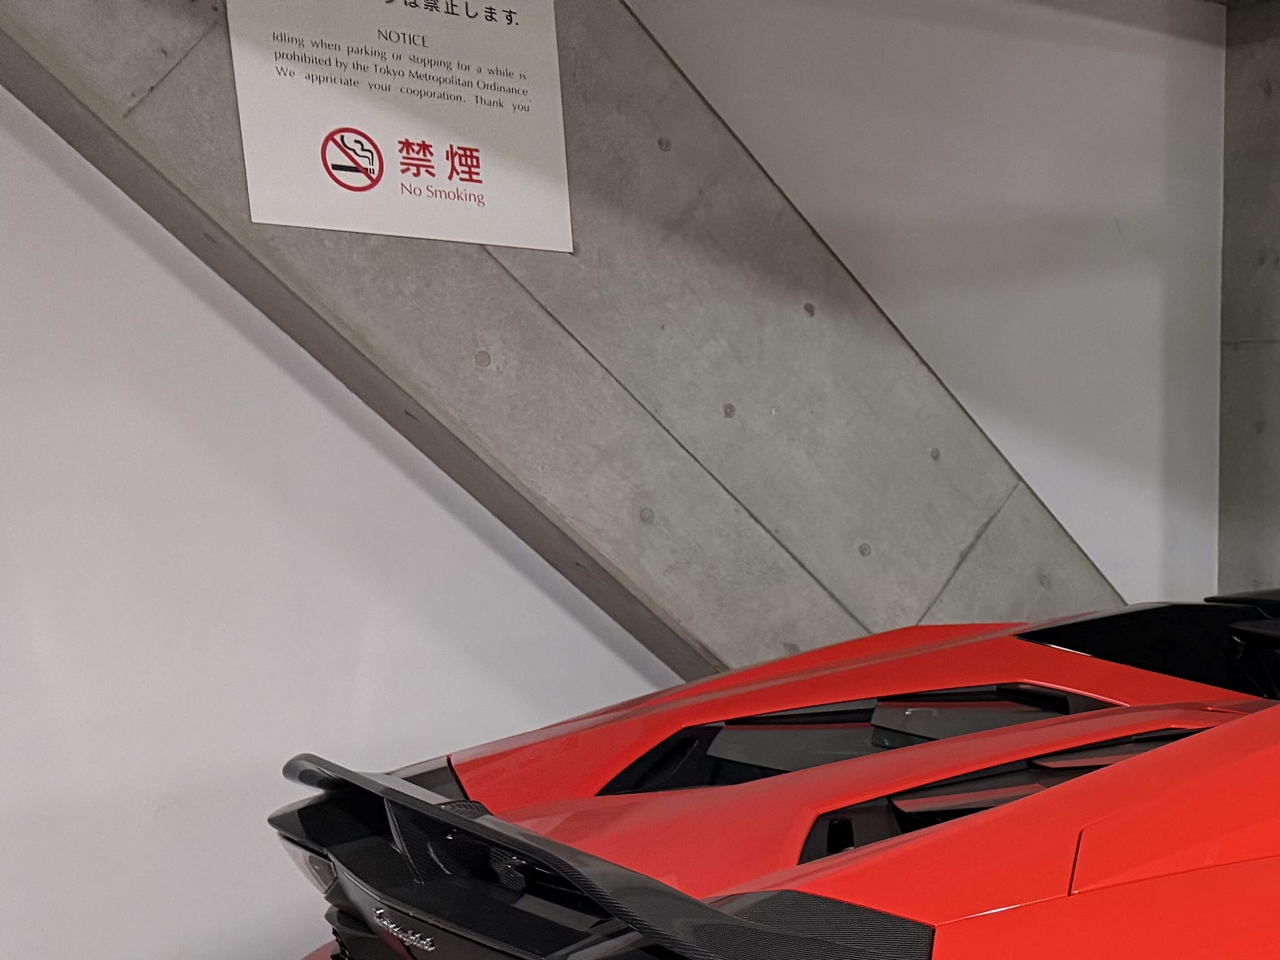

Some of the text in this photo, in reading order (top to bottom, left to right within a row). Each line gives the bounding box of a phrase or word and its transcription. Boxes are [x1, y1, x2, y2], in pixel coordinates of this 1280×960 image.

[272, 31, 527, 80] Idling when parking or stopping for a while is
[377, 28, 429, 48] NOTICE
[274, 51, 529, 96] prohibited by the Tokyo Metropolitan Ordinance
[275, 65, 296, 78] We
[367, 81, 392, 94] your
[474, 94, 504, 109] Thank
[511, 102, 530, 114] you
[397, 137, 484, 185] 禁煙
[400, 182, 486, 208] No Smoking
